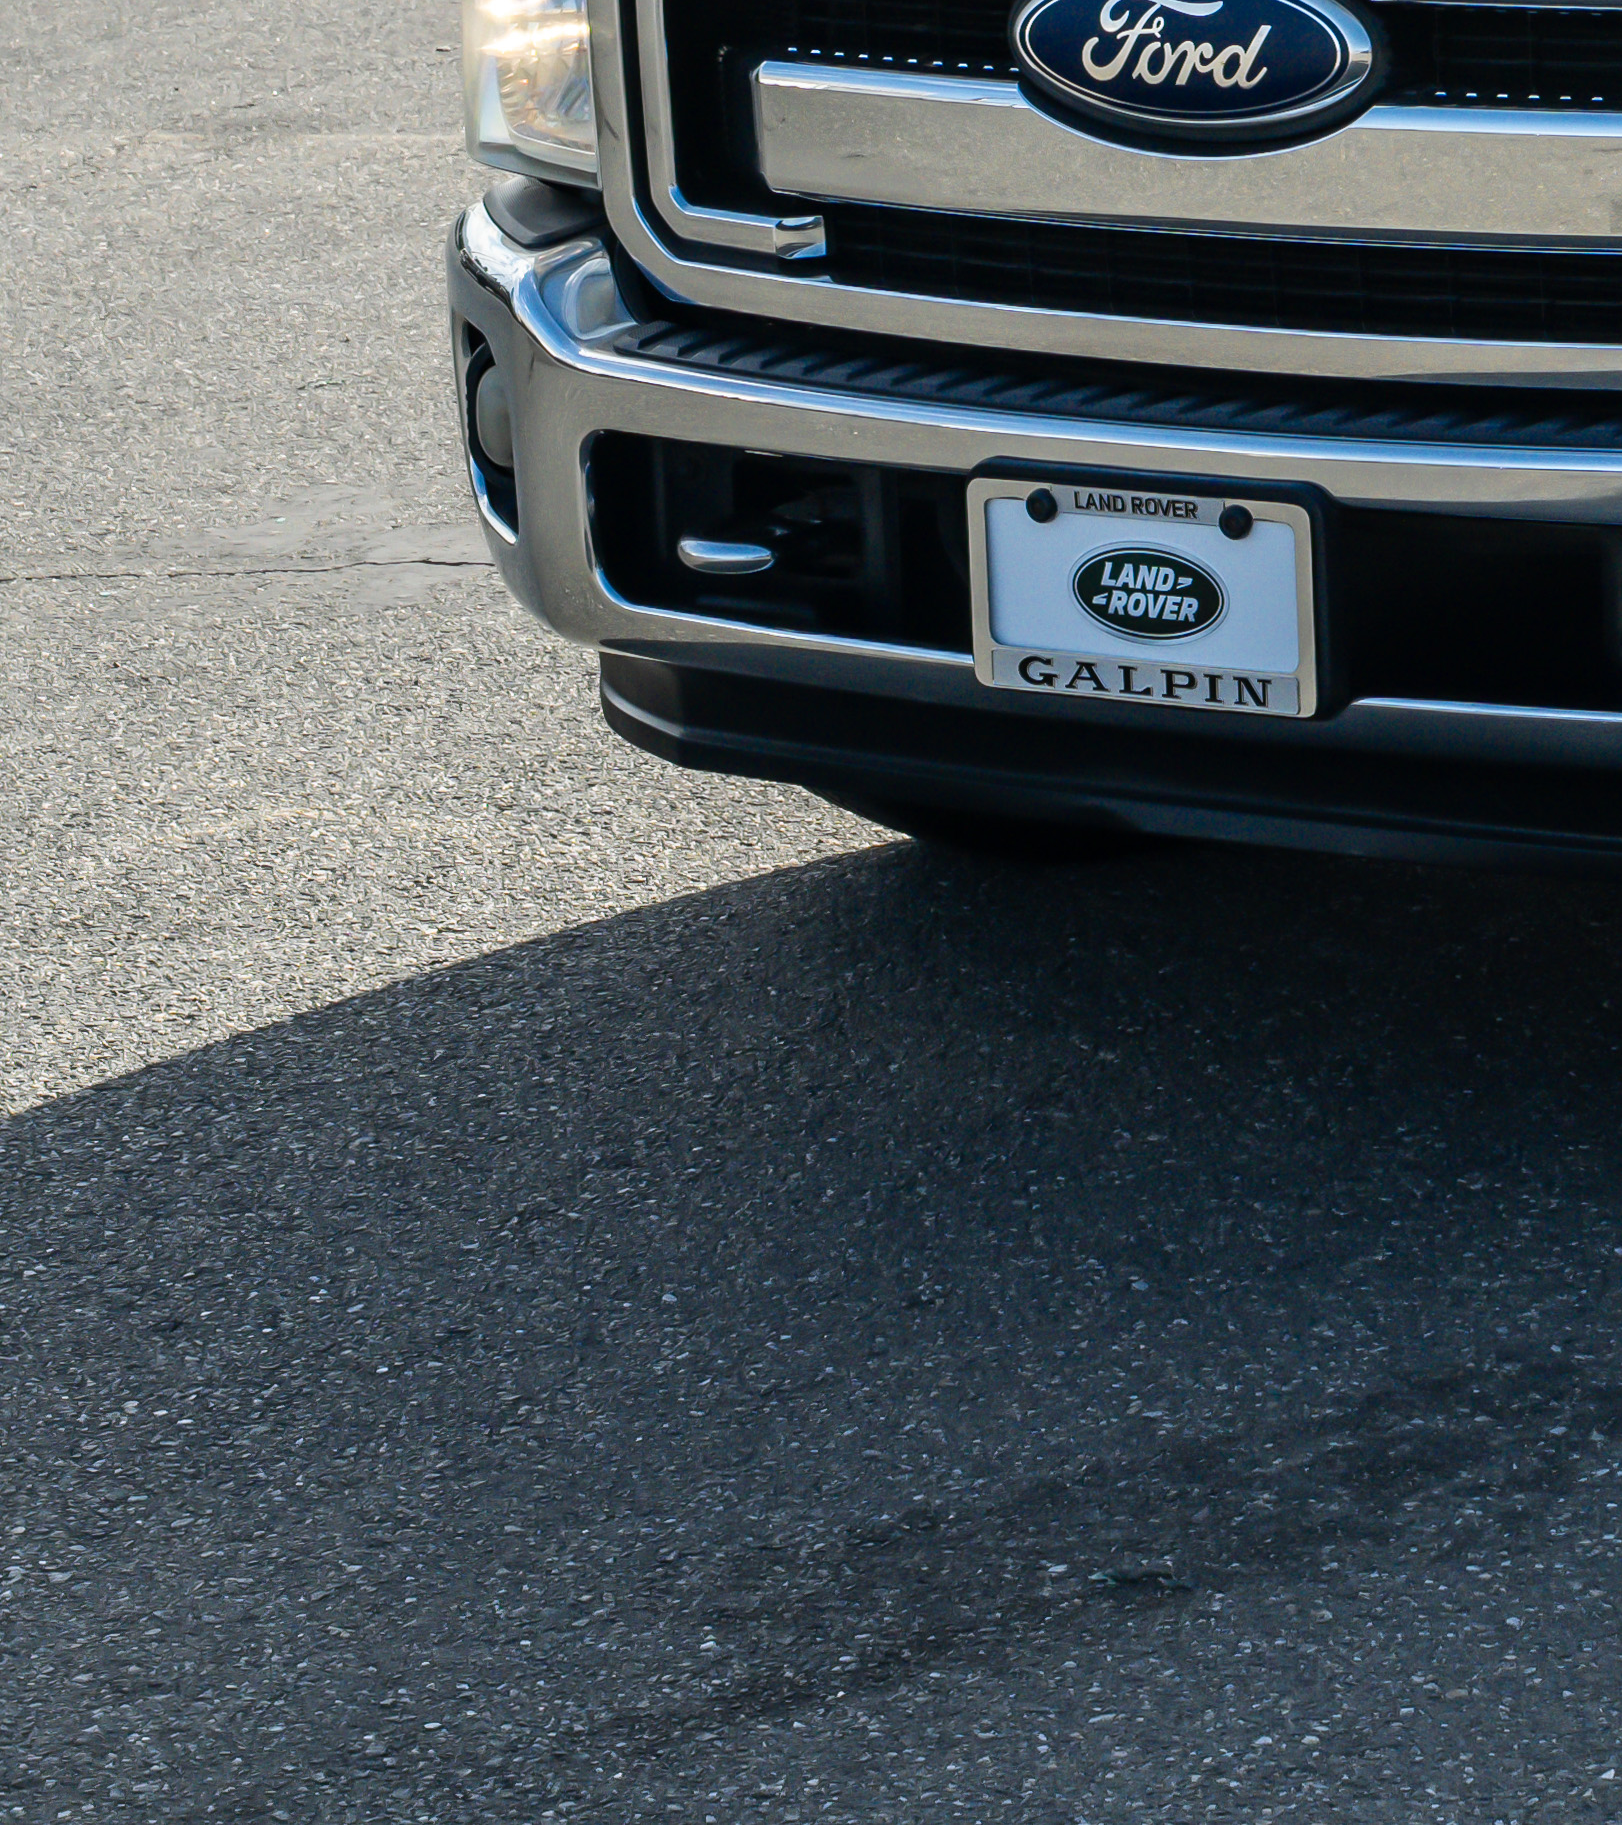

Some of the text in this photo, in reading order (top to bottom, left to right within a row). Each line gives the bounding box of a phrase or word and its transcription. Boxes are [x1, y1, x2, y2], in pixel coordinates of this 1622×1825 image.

[1074, 490, 1199, 520] LAND ROVER
[1100, 561, 1176, 592] LAND
[1107, 590, 1200, 622] ROVER
[1017, 655, 1273, 708] GALPIN
